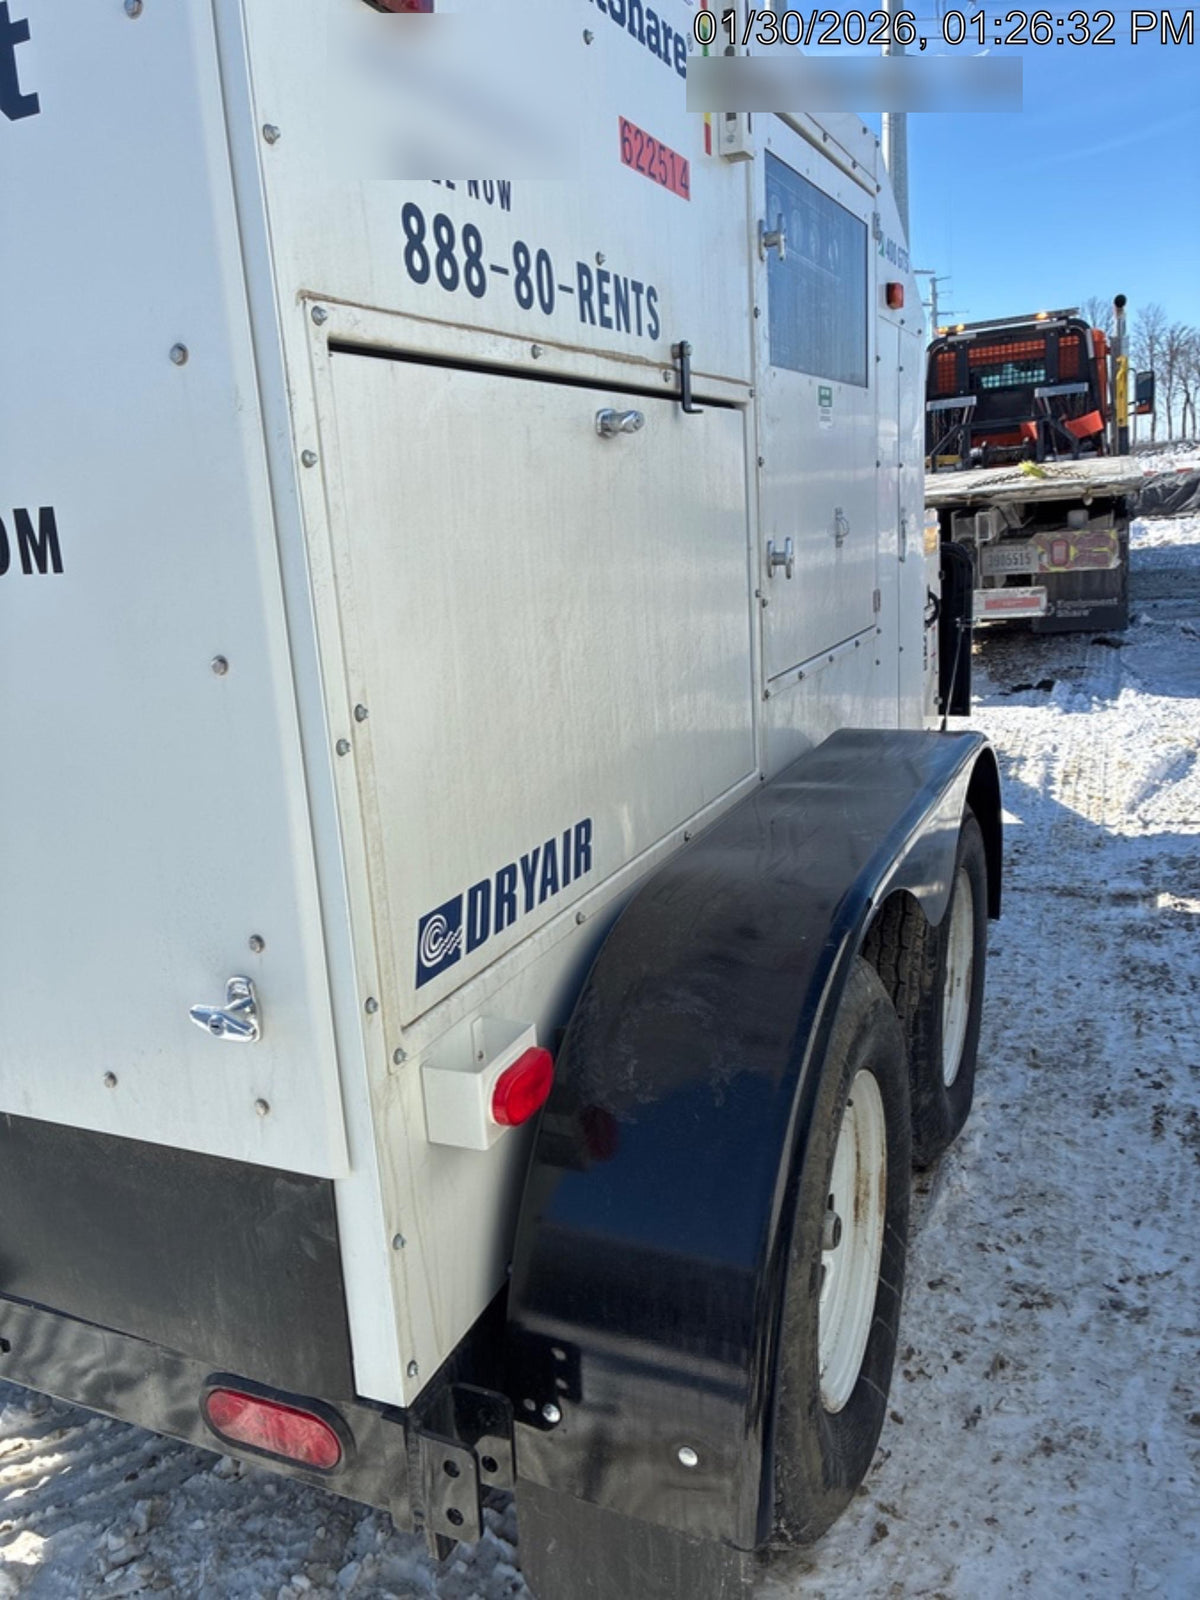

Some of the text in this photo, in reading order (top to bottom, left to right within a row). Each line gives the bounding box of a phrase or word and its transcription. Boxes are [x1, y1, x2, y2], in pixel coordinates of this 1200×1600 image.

[622, 119, 690, 193] 622514
[401, 202, 660, 340] 888-80-RENTS
[465, 817, 593, 955] DRYAIR
